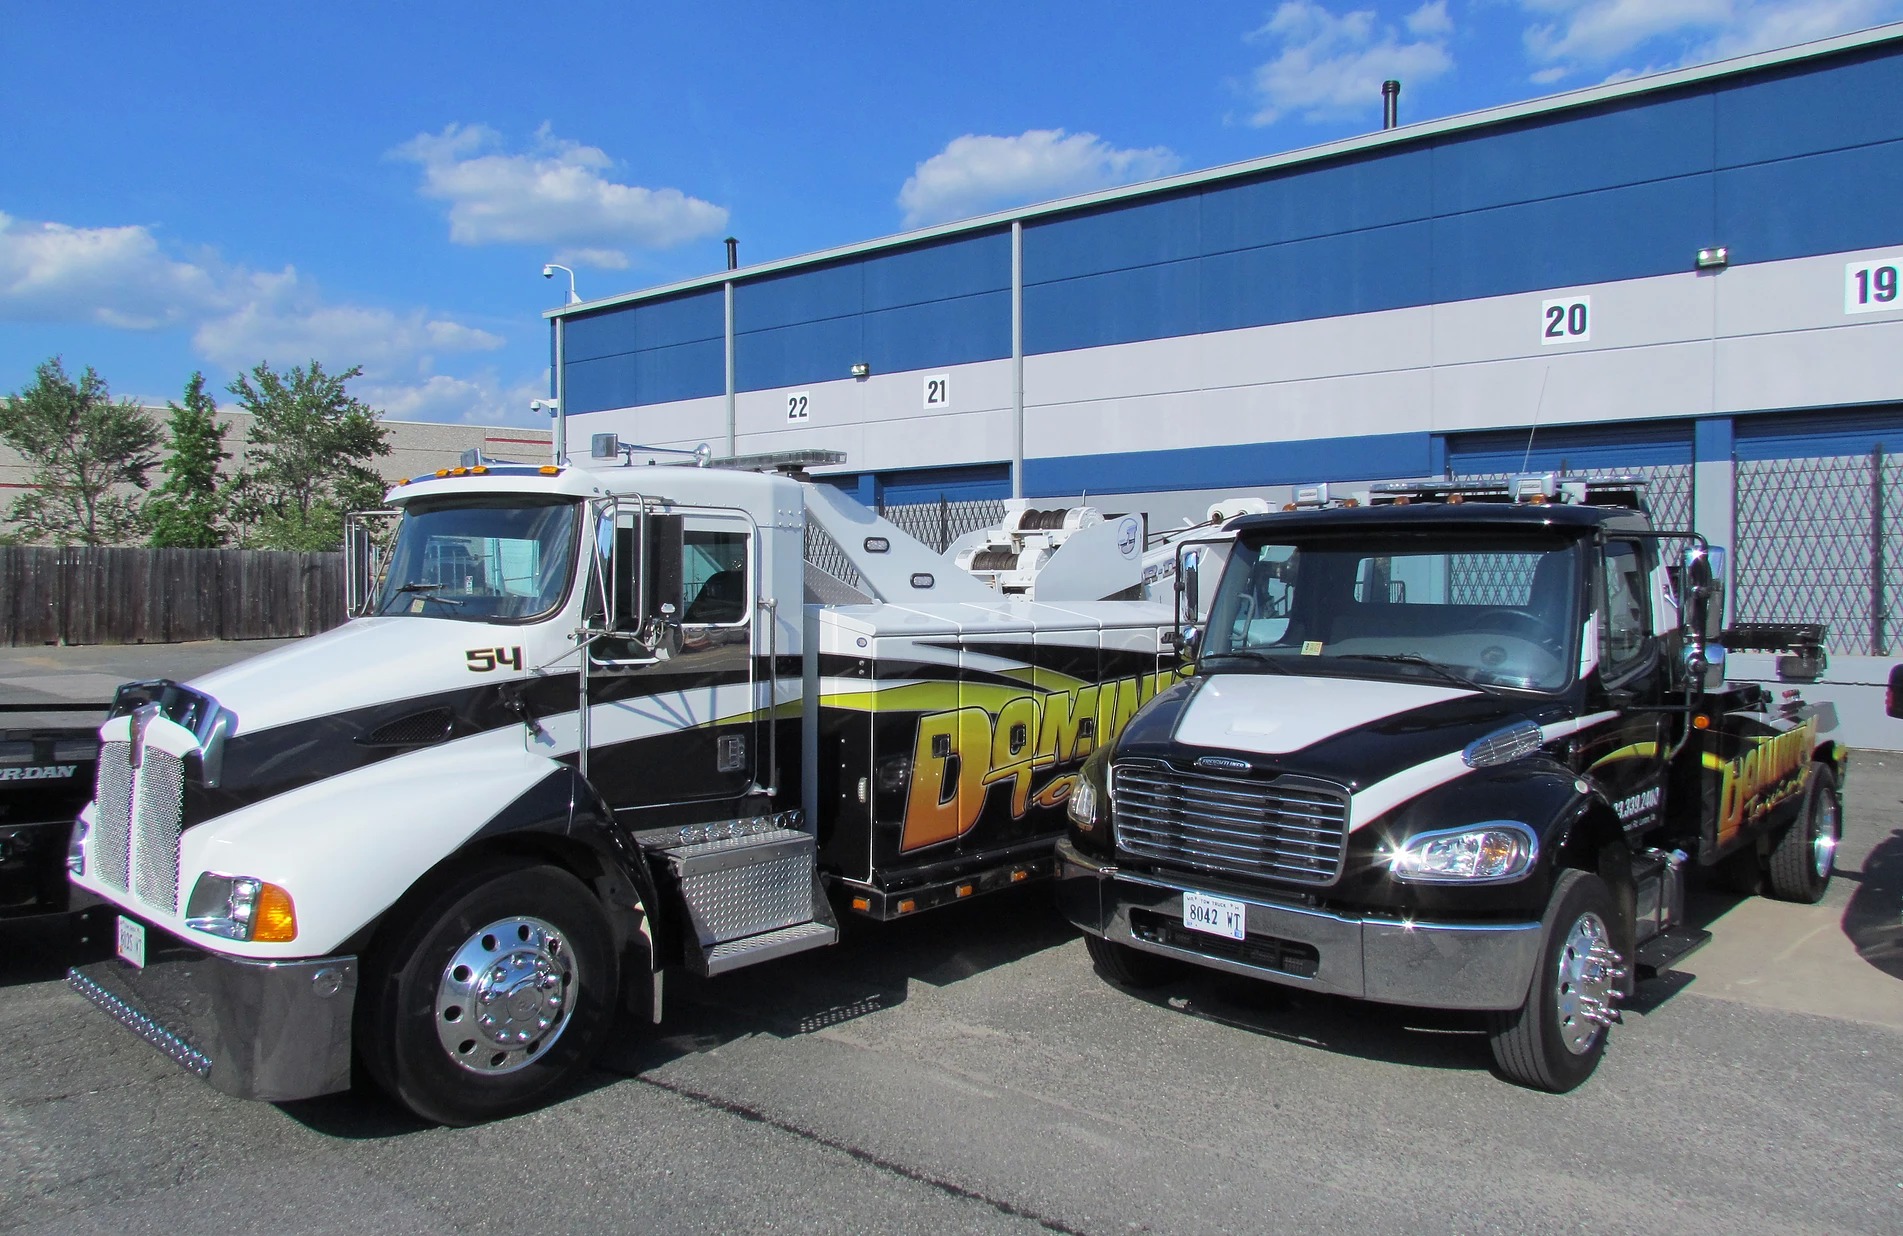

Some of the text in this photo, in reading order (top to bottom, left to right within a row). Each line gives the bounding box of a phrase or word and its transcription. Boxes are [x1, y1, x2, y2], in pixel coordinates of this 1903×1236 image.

[1855, 266, 1897, 304] 19
[1545, 303, 1587, 337] 20
[927, 379, 945, 403] 21
[788, 396, 808, 418] 22
[465, 645, 522, 673] 54
[0, 765, 78, 780] R-DAN
[1190, 904, 1241, 931] 8042 WT
